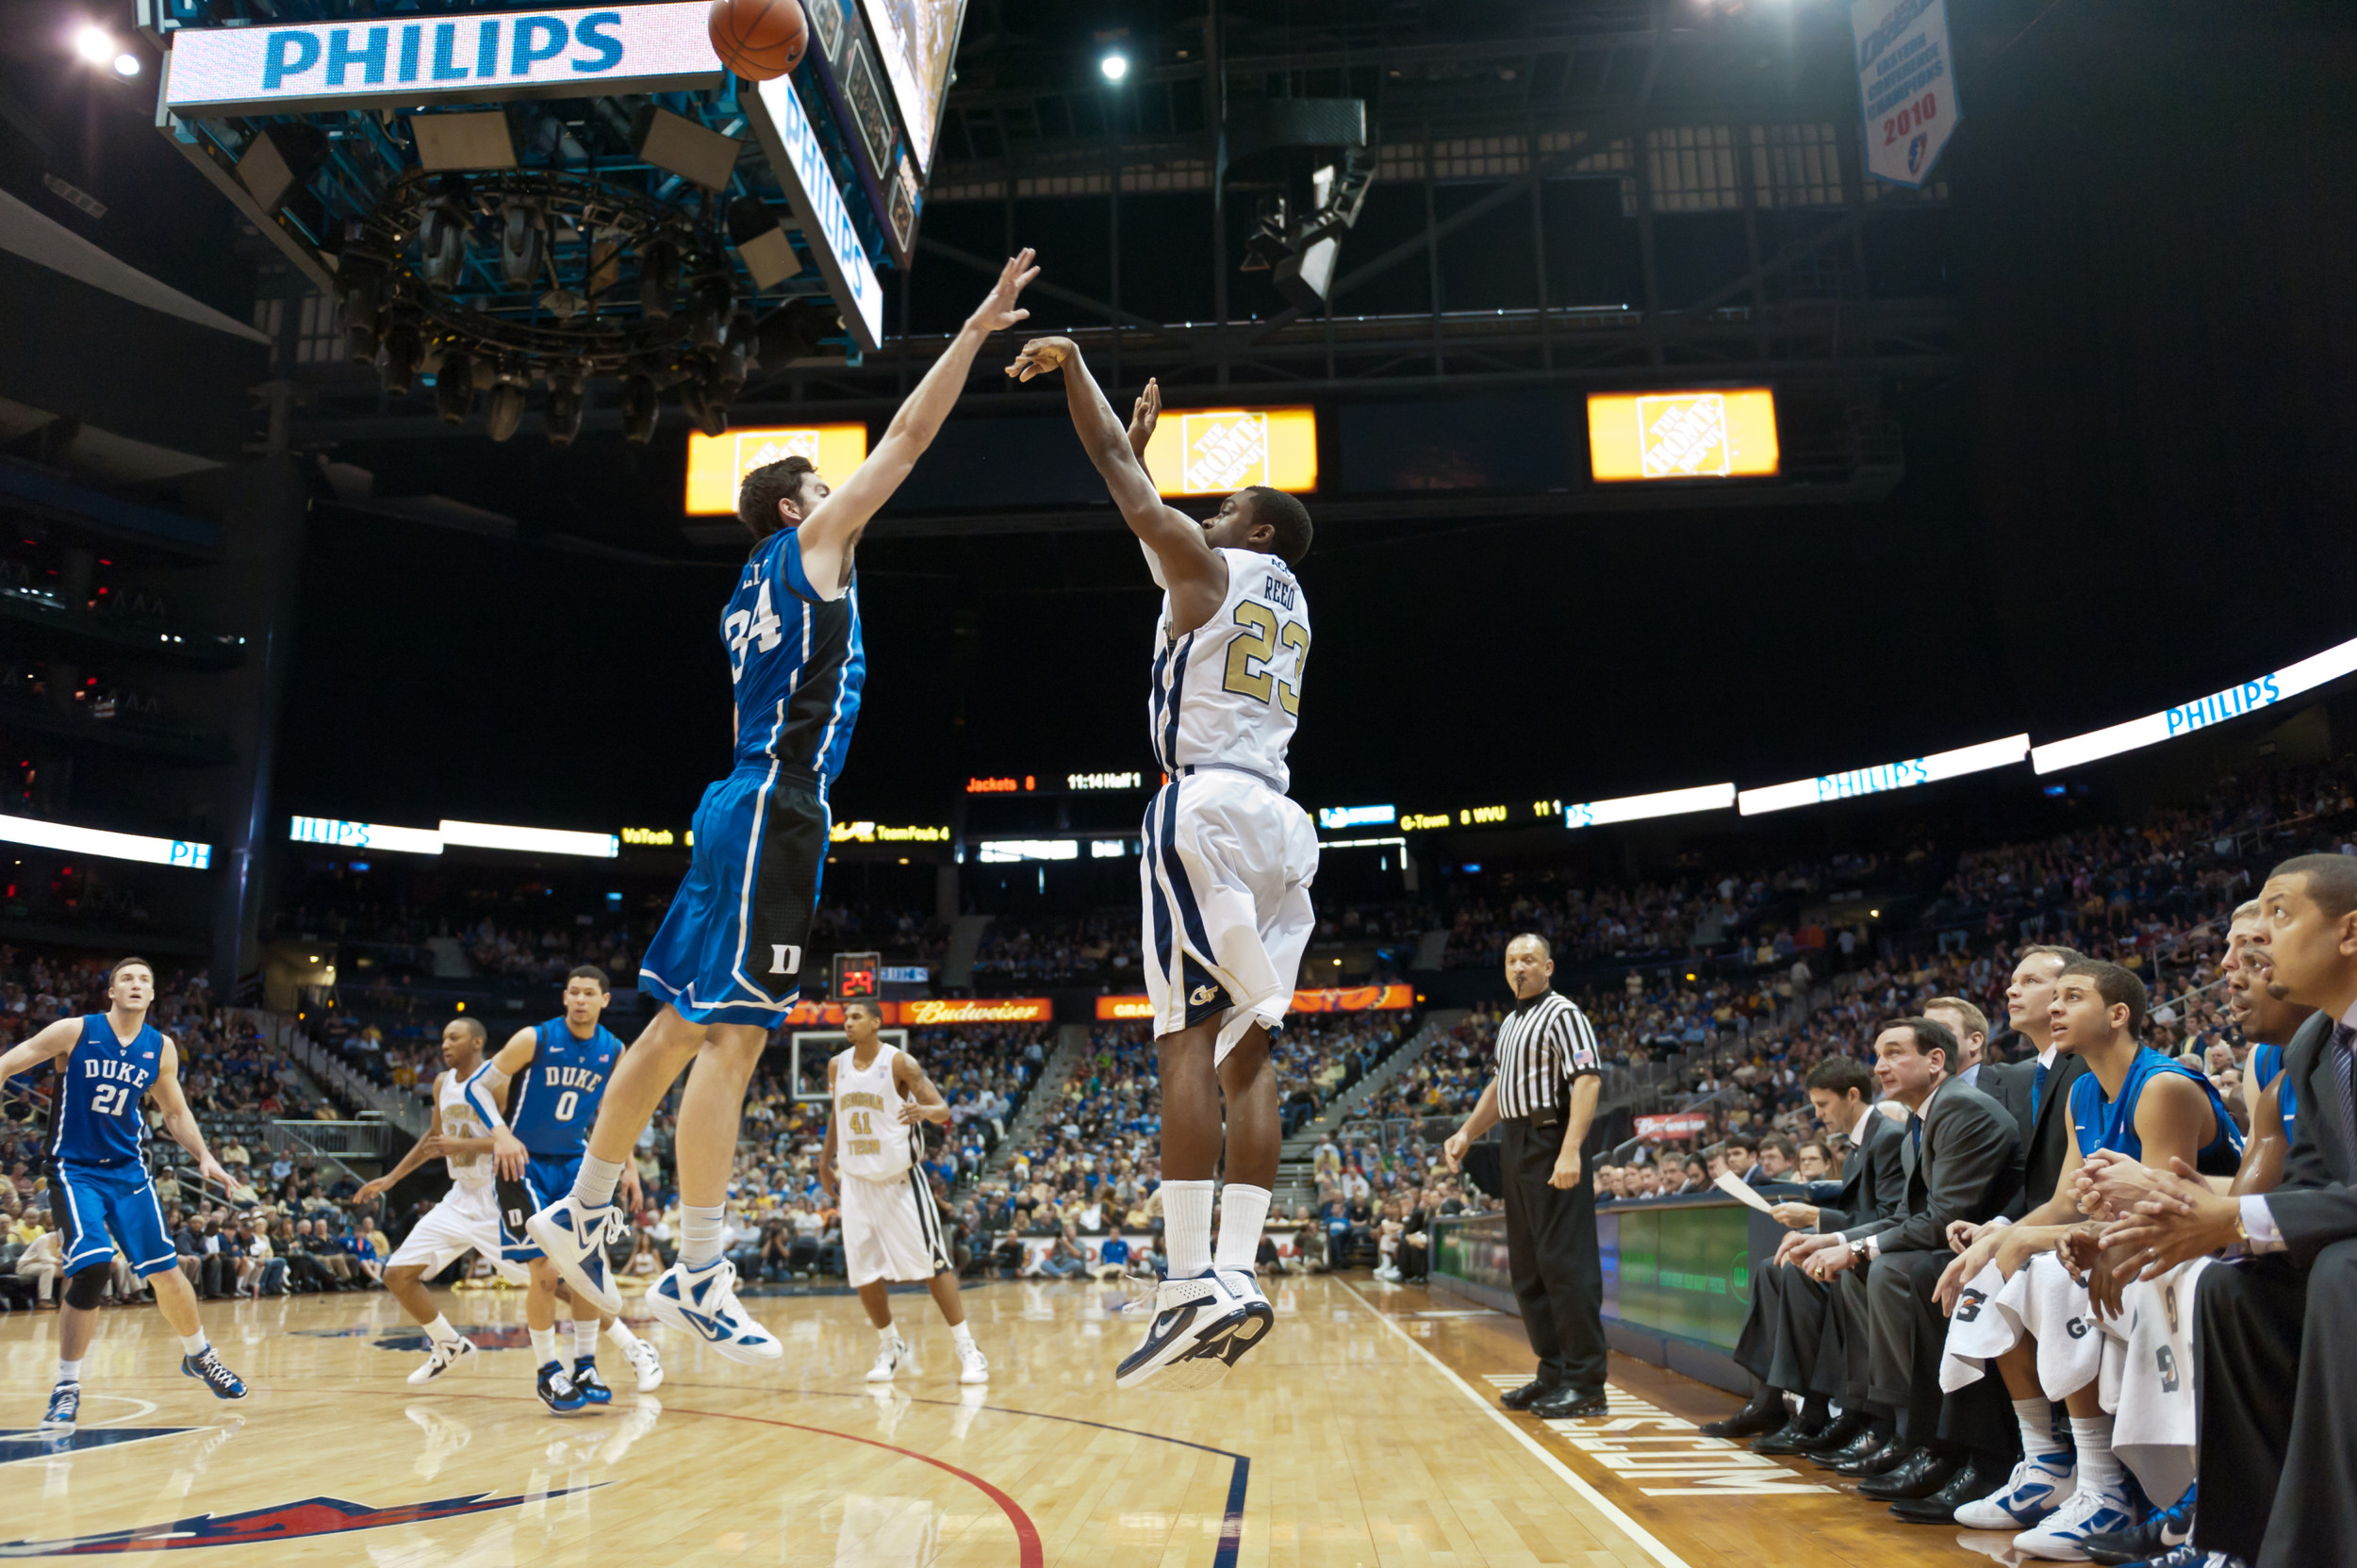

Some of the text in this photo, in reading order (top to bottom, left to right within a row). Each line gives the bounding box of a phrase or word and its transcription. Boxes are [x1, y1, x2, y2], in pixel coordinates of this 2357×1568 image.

[262, 11, 623, 90] PHILIPS
[1884, 92, 1937, 146] 2010
[786, 84, 862, 301] PHILIPS
[1187, 412, 1263, 490] HOME
[1193, 422, 1227, 454] THE
[1271, 558, 1291, 577] ACC
[1264, 576, 1294, 611] REED
[725, 578, 782, 685] 34
[1222, 599, 1309, 718] 23
[2166, 673, 2280, 737] PHILIPS
[966, 775, 1035, 792] Jackets 8
[1067, 774, 1103, 789] 11:14
[1132, 772, 1141, 787] 1
[1817, 757, 1927, 801] PHILIPS
[1400, 815, 1449, 831] G-Town
[1473, 805, 1507, 823] WVU
[622, 827, 674, 845] VaTech
[769, 945, 801, 975] D
[842, 971, 873, 997] 29
[911, 1000, 1039, 1024] Budweiser
[84, 1059, 149, 1088] DUKE
[545, 1065, 602, 1093] DUKE
[91, 1083, 129, 1116] 21
[555, 1091, 578, 1121] 0
[849, 1112, 872, 1134] 41
[847, 1139, 881, 1155] TECH
[508, 1209, 523, 1227] D
